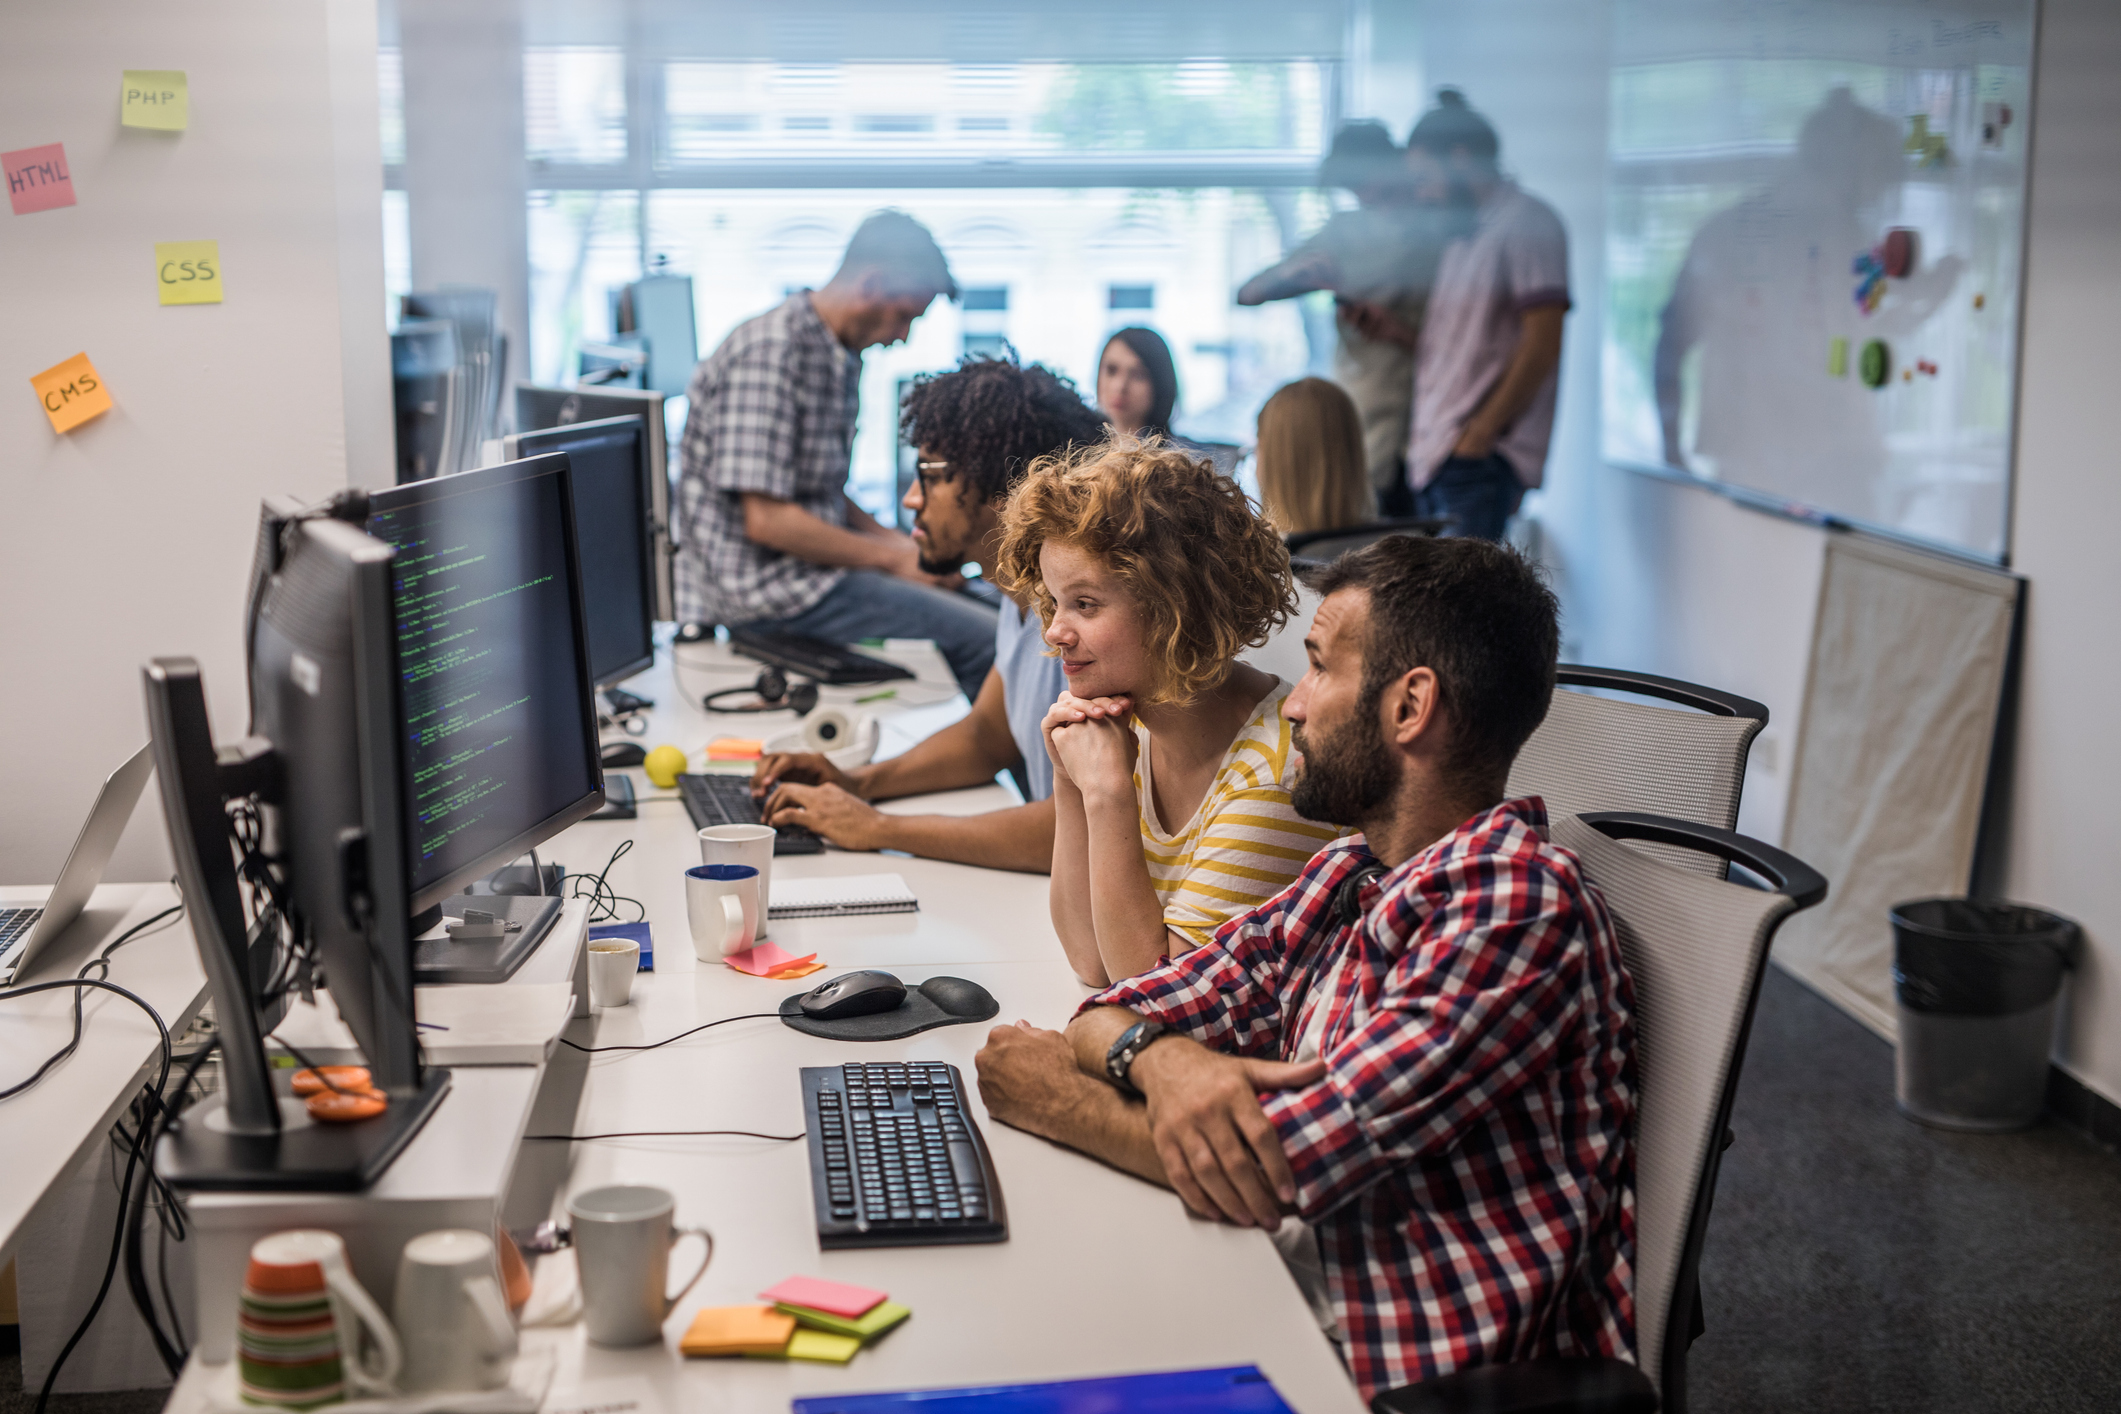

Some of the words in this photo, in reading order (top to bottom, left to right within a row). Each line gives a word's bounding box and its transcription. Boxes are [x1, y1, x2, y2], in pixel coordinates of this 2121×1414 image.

[127, 88, 174, 105] PHP
[8, 161, 69, 193] HTML
[161, 261, 215, 284] CSS
[45, 373, 98, 412] CMS
